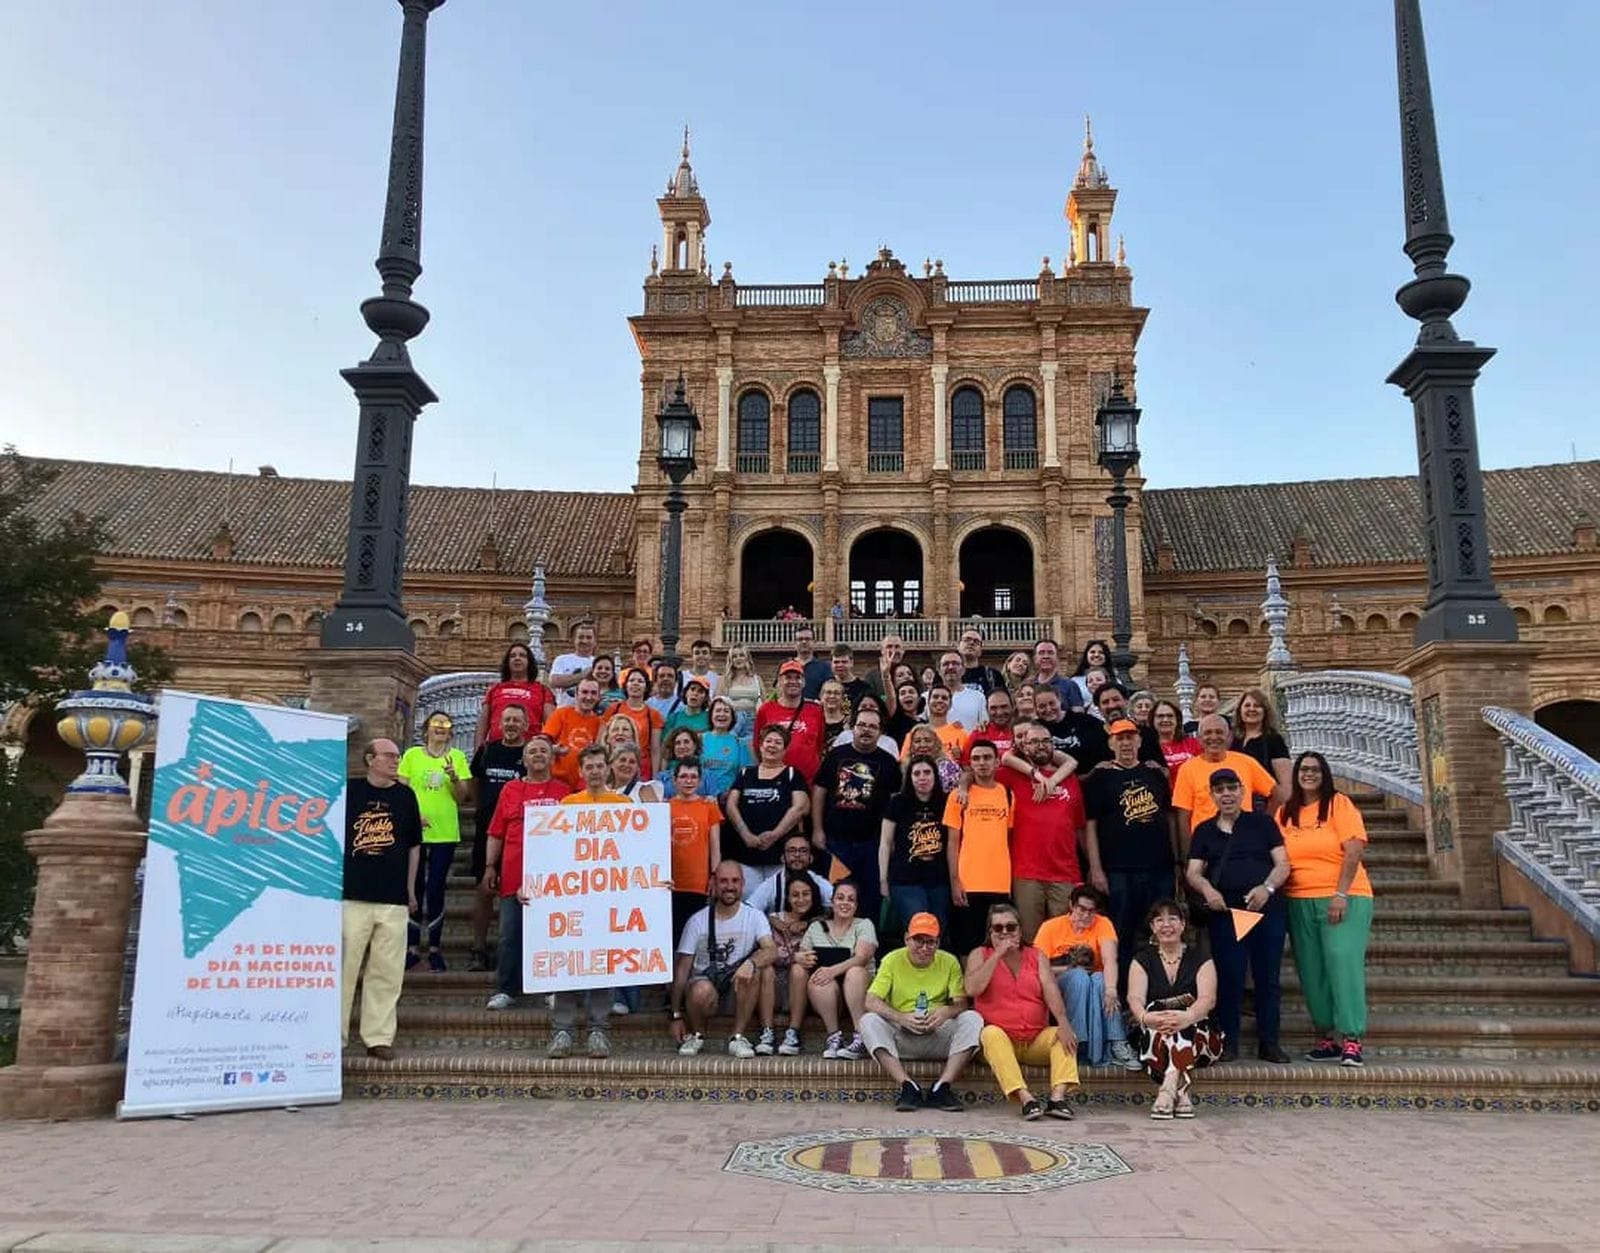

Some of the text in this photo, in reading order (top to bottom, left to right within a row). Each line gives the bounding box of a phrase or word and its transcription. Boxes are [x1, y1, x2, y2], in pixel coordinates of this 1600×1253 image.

[528, 809, 650, 836] 24 MAYO
[574, 838, 620, 861] DIA
[524, 863, 667, 900] NACIONAL
[548, 907, 648, 938] DE LA
[233, 944, 336, 956] 24 DE MAYO
[532, 947, 668, 977] EPILEPSIA
[207, 961, 336, 972] DIA NACIONAL
[187, 977, 336, 989] DE LA EPILEPSIA
